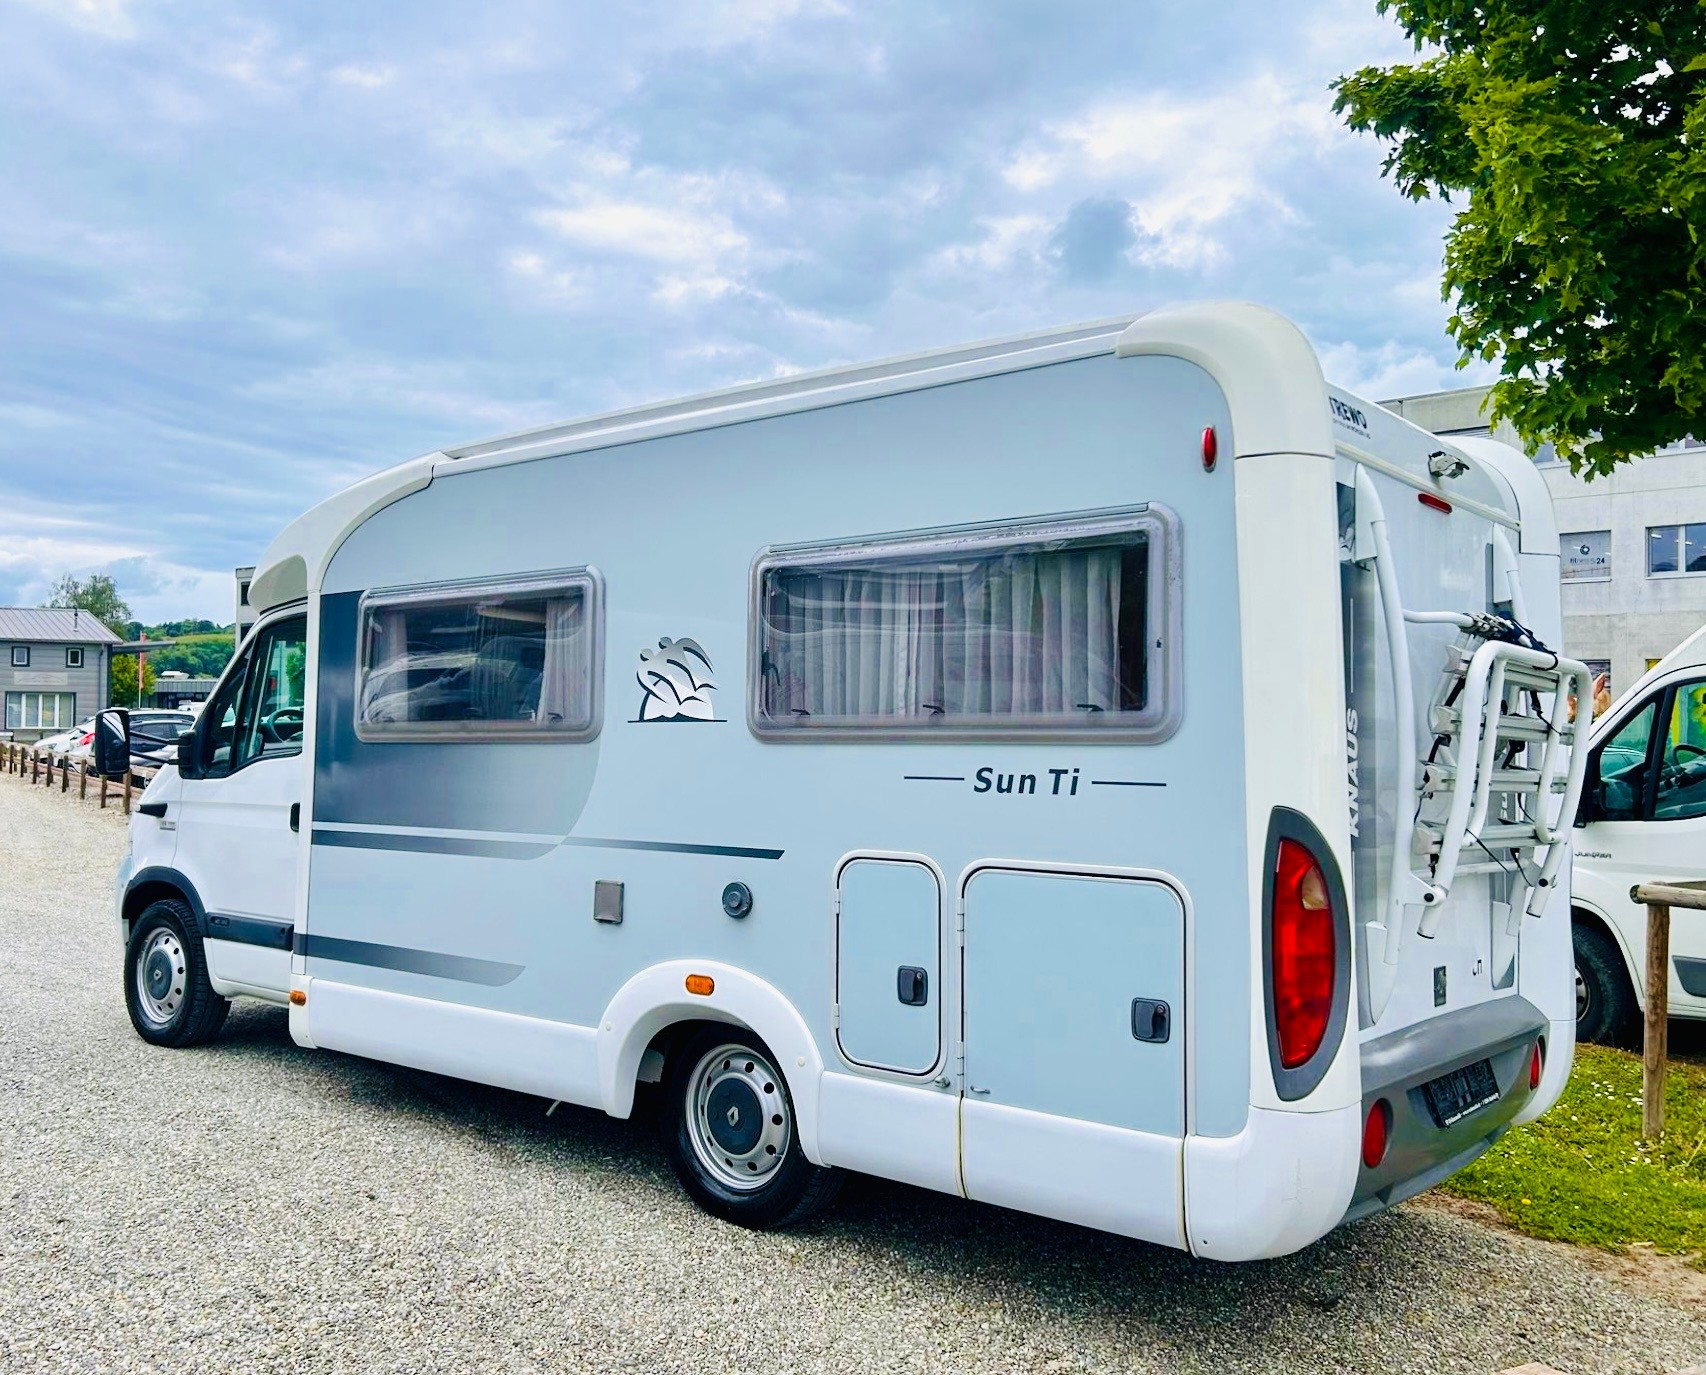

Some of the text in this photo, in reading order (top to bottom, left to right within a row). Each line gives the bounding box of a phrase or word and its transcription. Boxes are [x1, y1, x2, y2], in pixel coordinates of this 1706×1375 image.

[974, 767, 1080, 796] Sun Ti
[1347, 707, 1359, 838] KNAUS
